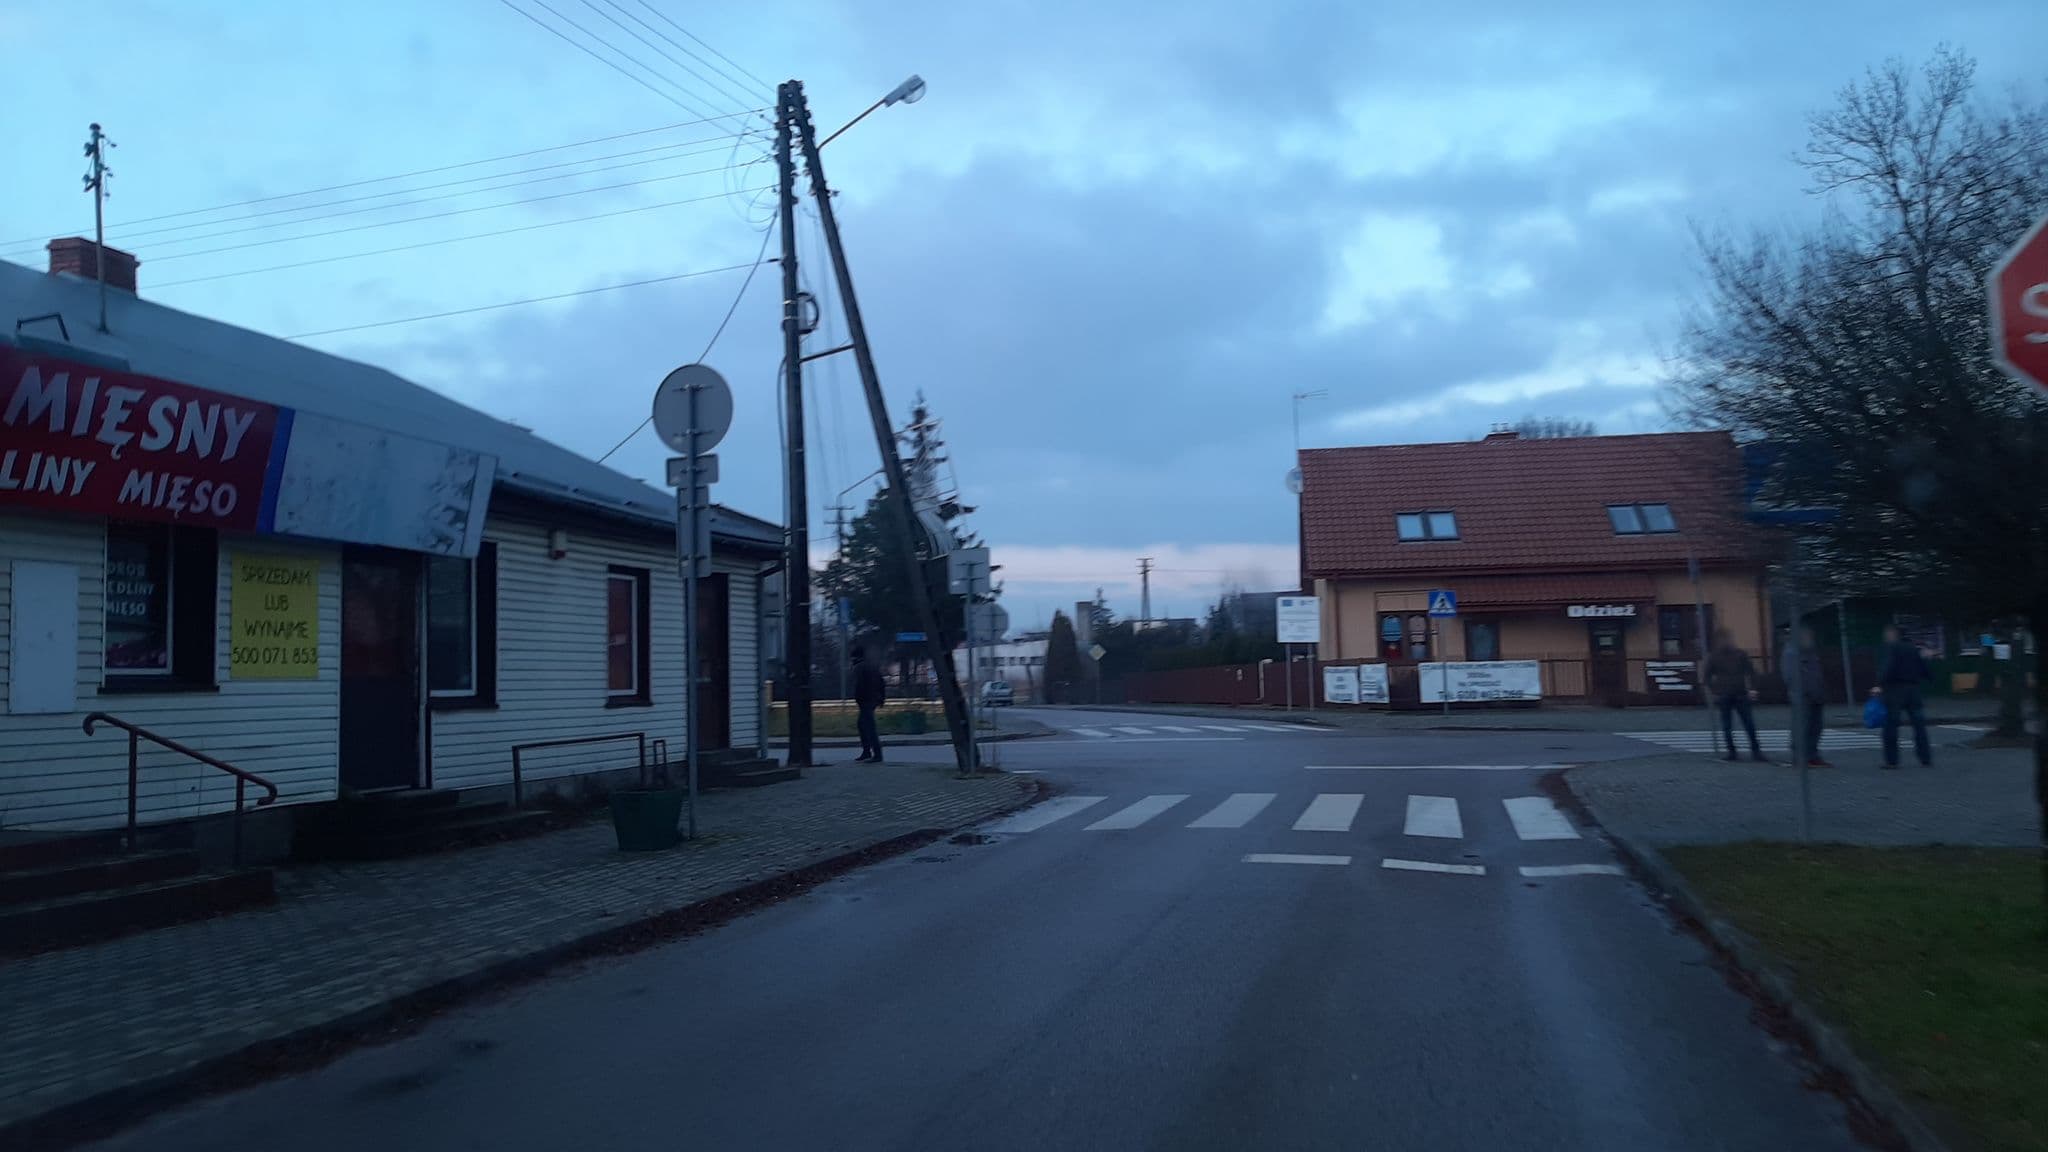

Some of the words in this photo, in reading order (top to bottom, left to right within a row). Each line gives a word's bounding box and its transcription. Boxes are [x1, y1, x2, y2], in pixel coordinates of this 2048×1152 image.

[3, 365, 257, 462] MIĘSNY
[117, 469, 239, 519] MIĘSO
[241, 563, 312, 585] SPRZEDAM
[265, 592, 288, 612] LUB
[232, 647, 259, 665] 500
[262, 648, 288, 665] 071
[292, 647, 319, 665] 853
